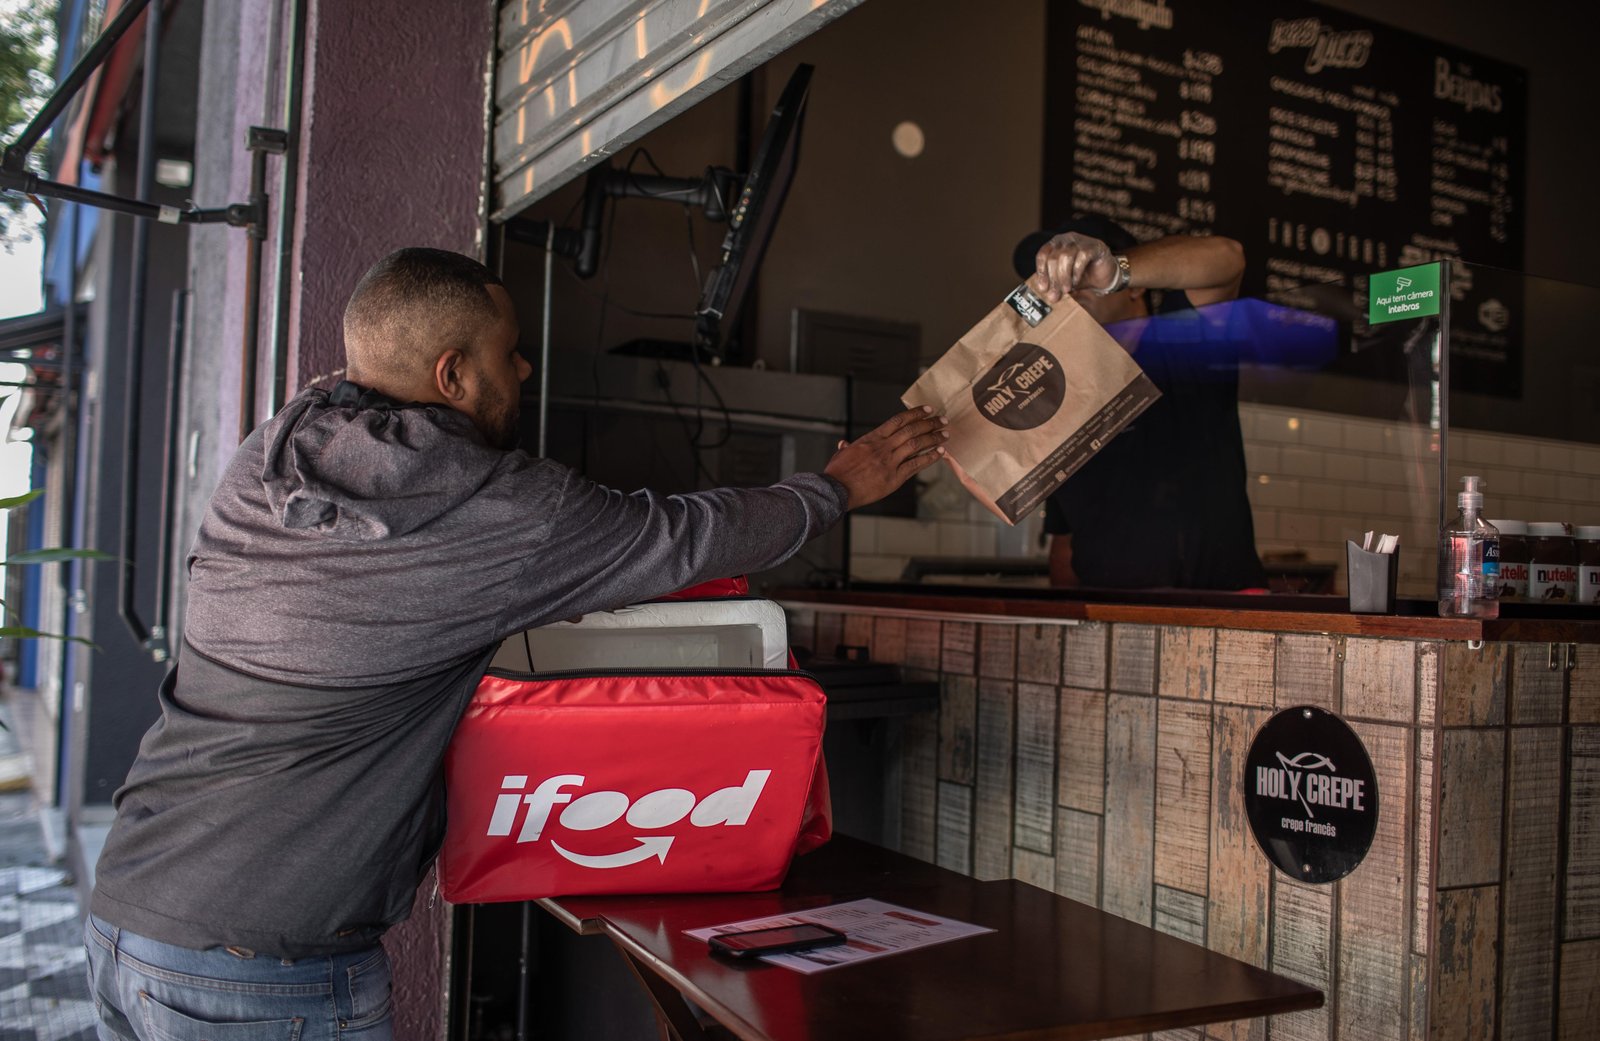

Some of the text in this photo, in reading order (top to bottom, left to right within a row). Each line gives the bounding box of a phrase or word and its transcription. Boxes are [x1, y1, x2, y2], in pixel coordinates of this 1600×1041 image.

[1376, 290, 1433, 306] Aqui tem câmera
[1388, 302, 1420, 314] intelbras
[984, 355, 1053, 416] HOLY CREPE
[1256, 766, 1365, 811] HOLY CREPE
[487, 769, 772, 844] ifood
[1281, 817, 1336, 837] crepe francês
